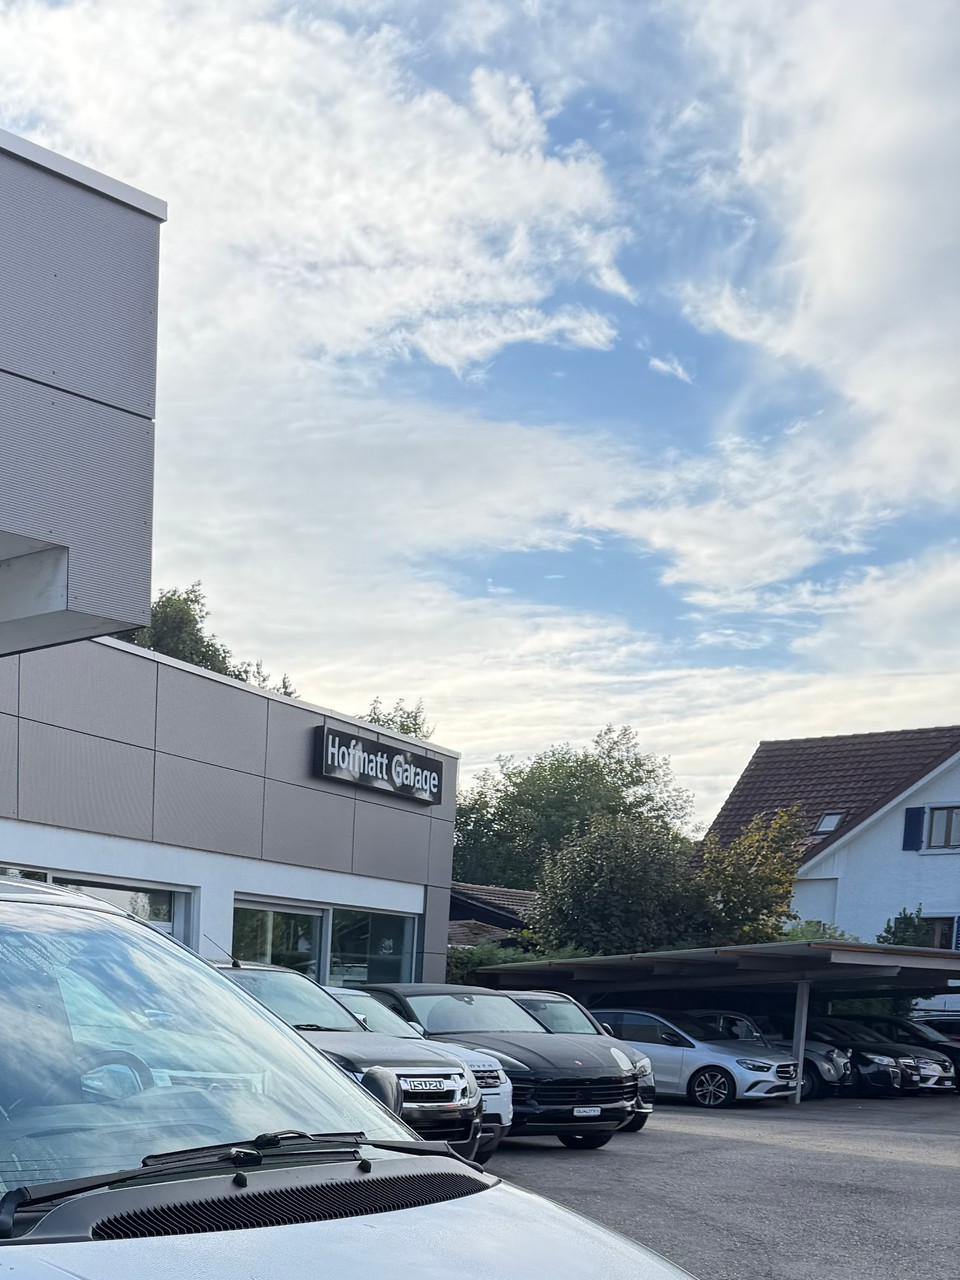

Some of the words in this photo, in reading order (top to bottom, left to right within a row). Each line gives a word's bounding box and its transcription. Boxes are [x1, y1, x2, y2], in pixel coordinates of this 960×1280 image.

[327, 734, 388, 780] Hofmatt
[391, 754, 439, 796] Garage
[410, 1080, 444, 1090] ISUZU
